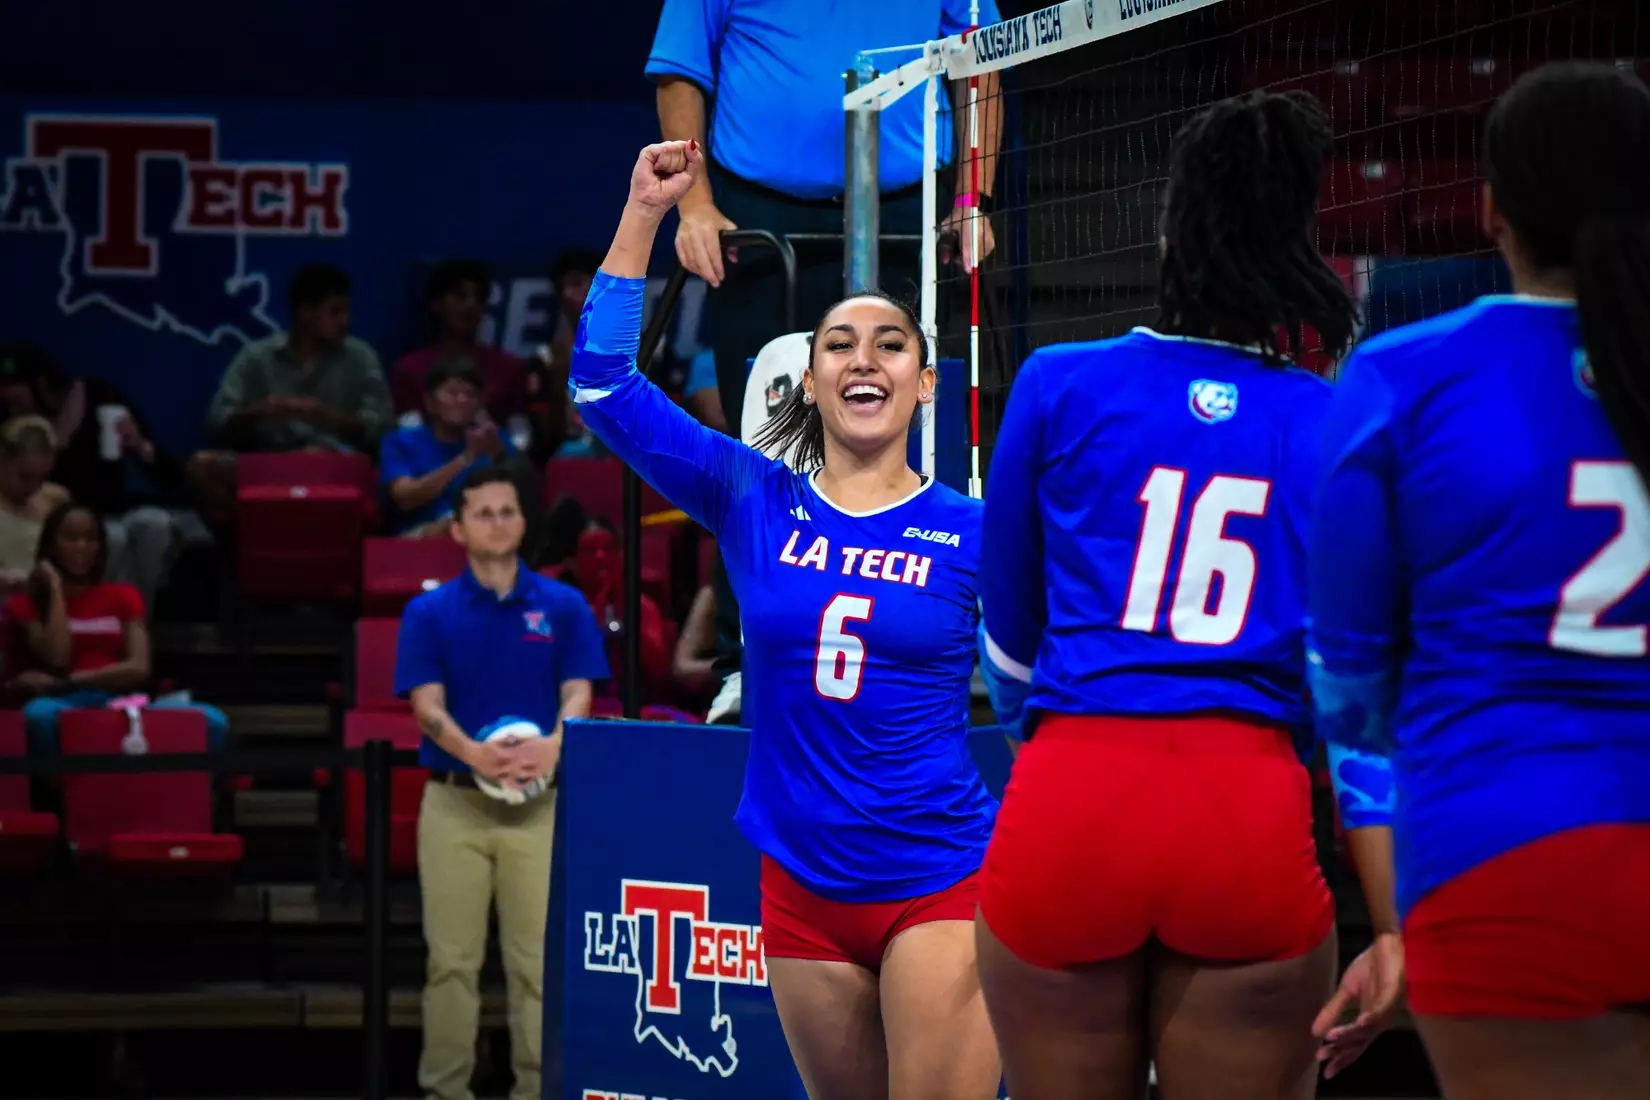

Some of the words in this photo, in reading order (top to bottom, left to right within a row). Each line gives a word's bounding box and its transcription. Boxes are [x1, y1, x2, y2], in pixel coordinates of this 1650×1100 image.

[973, 15, 1029, 64] LOUISIANA
[1033, 5, 1062, 46] TECH
[0, 157, 68, 232] A
[779, 530, 829, 571] LA
[842, 547, 932, 588] TECH
[1120, 465, 1271, 646] 16
[1549, 459, 1650, 656] 2
[813, 592, 874, 703] 6
[584, 911, 643, 974] LA
[620, 878, 769, 1015] TECH
